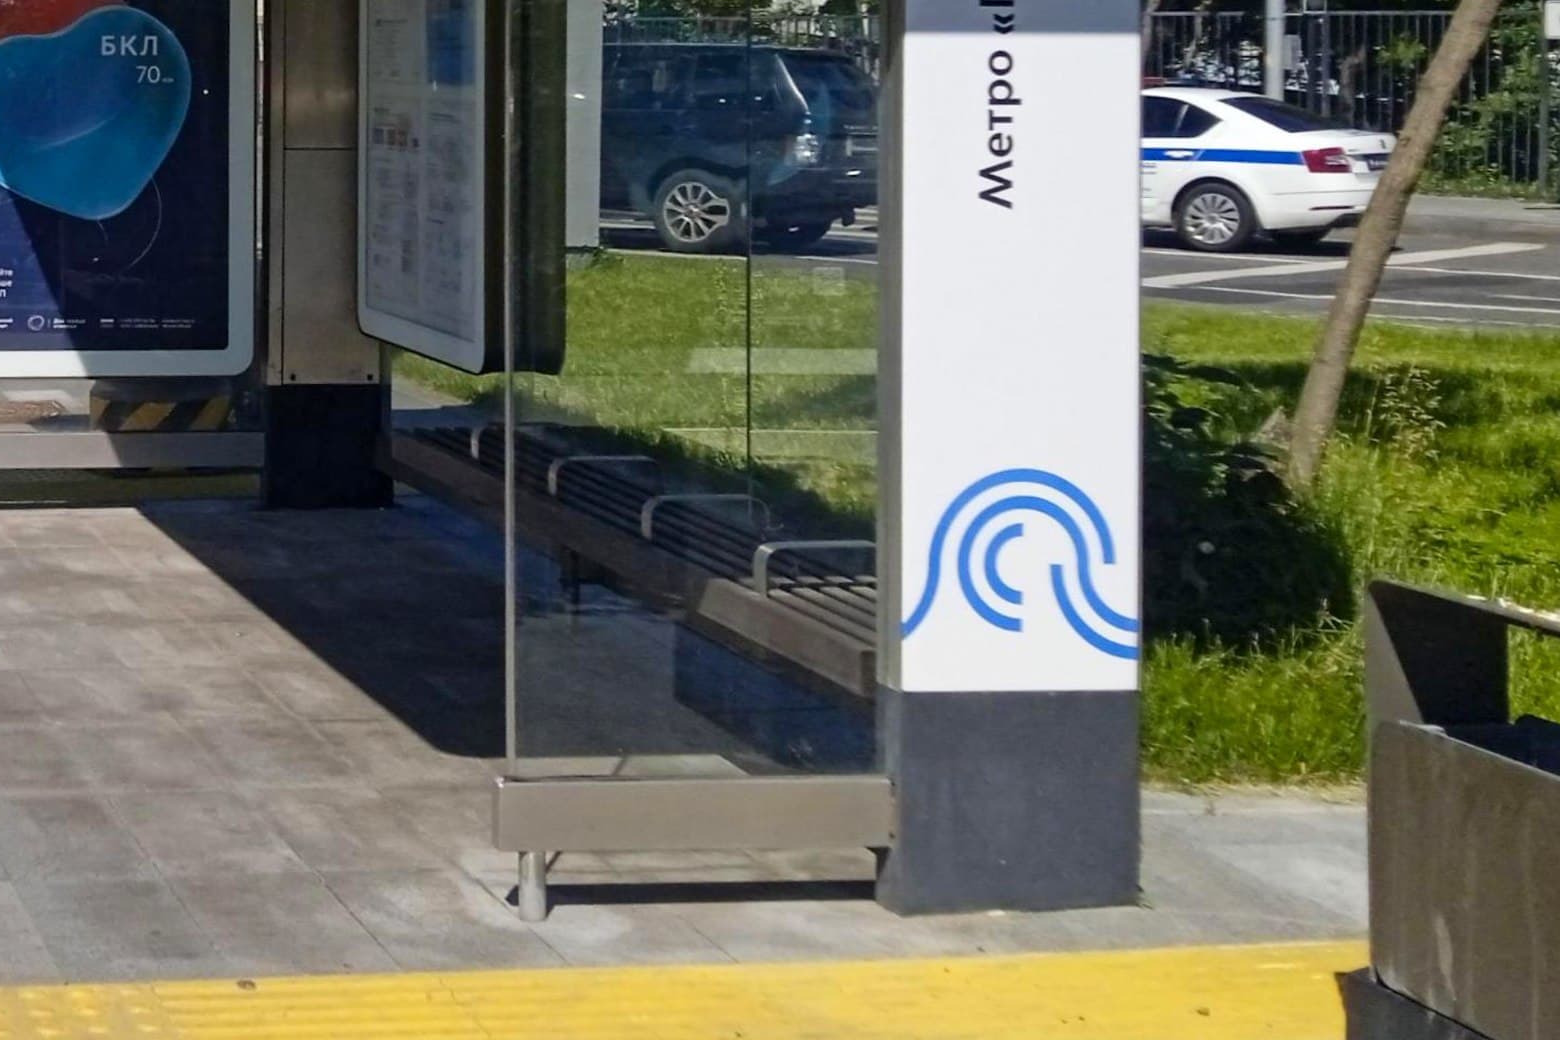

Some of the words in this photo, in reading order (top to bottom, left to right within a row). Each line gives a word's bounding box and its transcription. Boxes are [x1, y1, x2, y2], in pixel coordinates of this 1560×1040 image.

[100, 35, 159, 57] БКЛ
[135, 65, 162, 84] 70
[978, 49, 1023, 210] Метро
